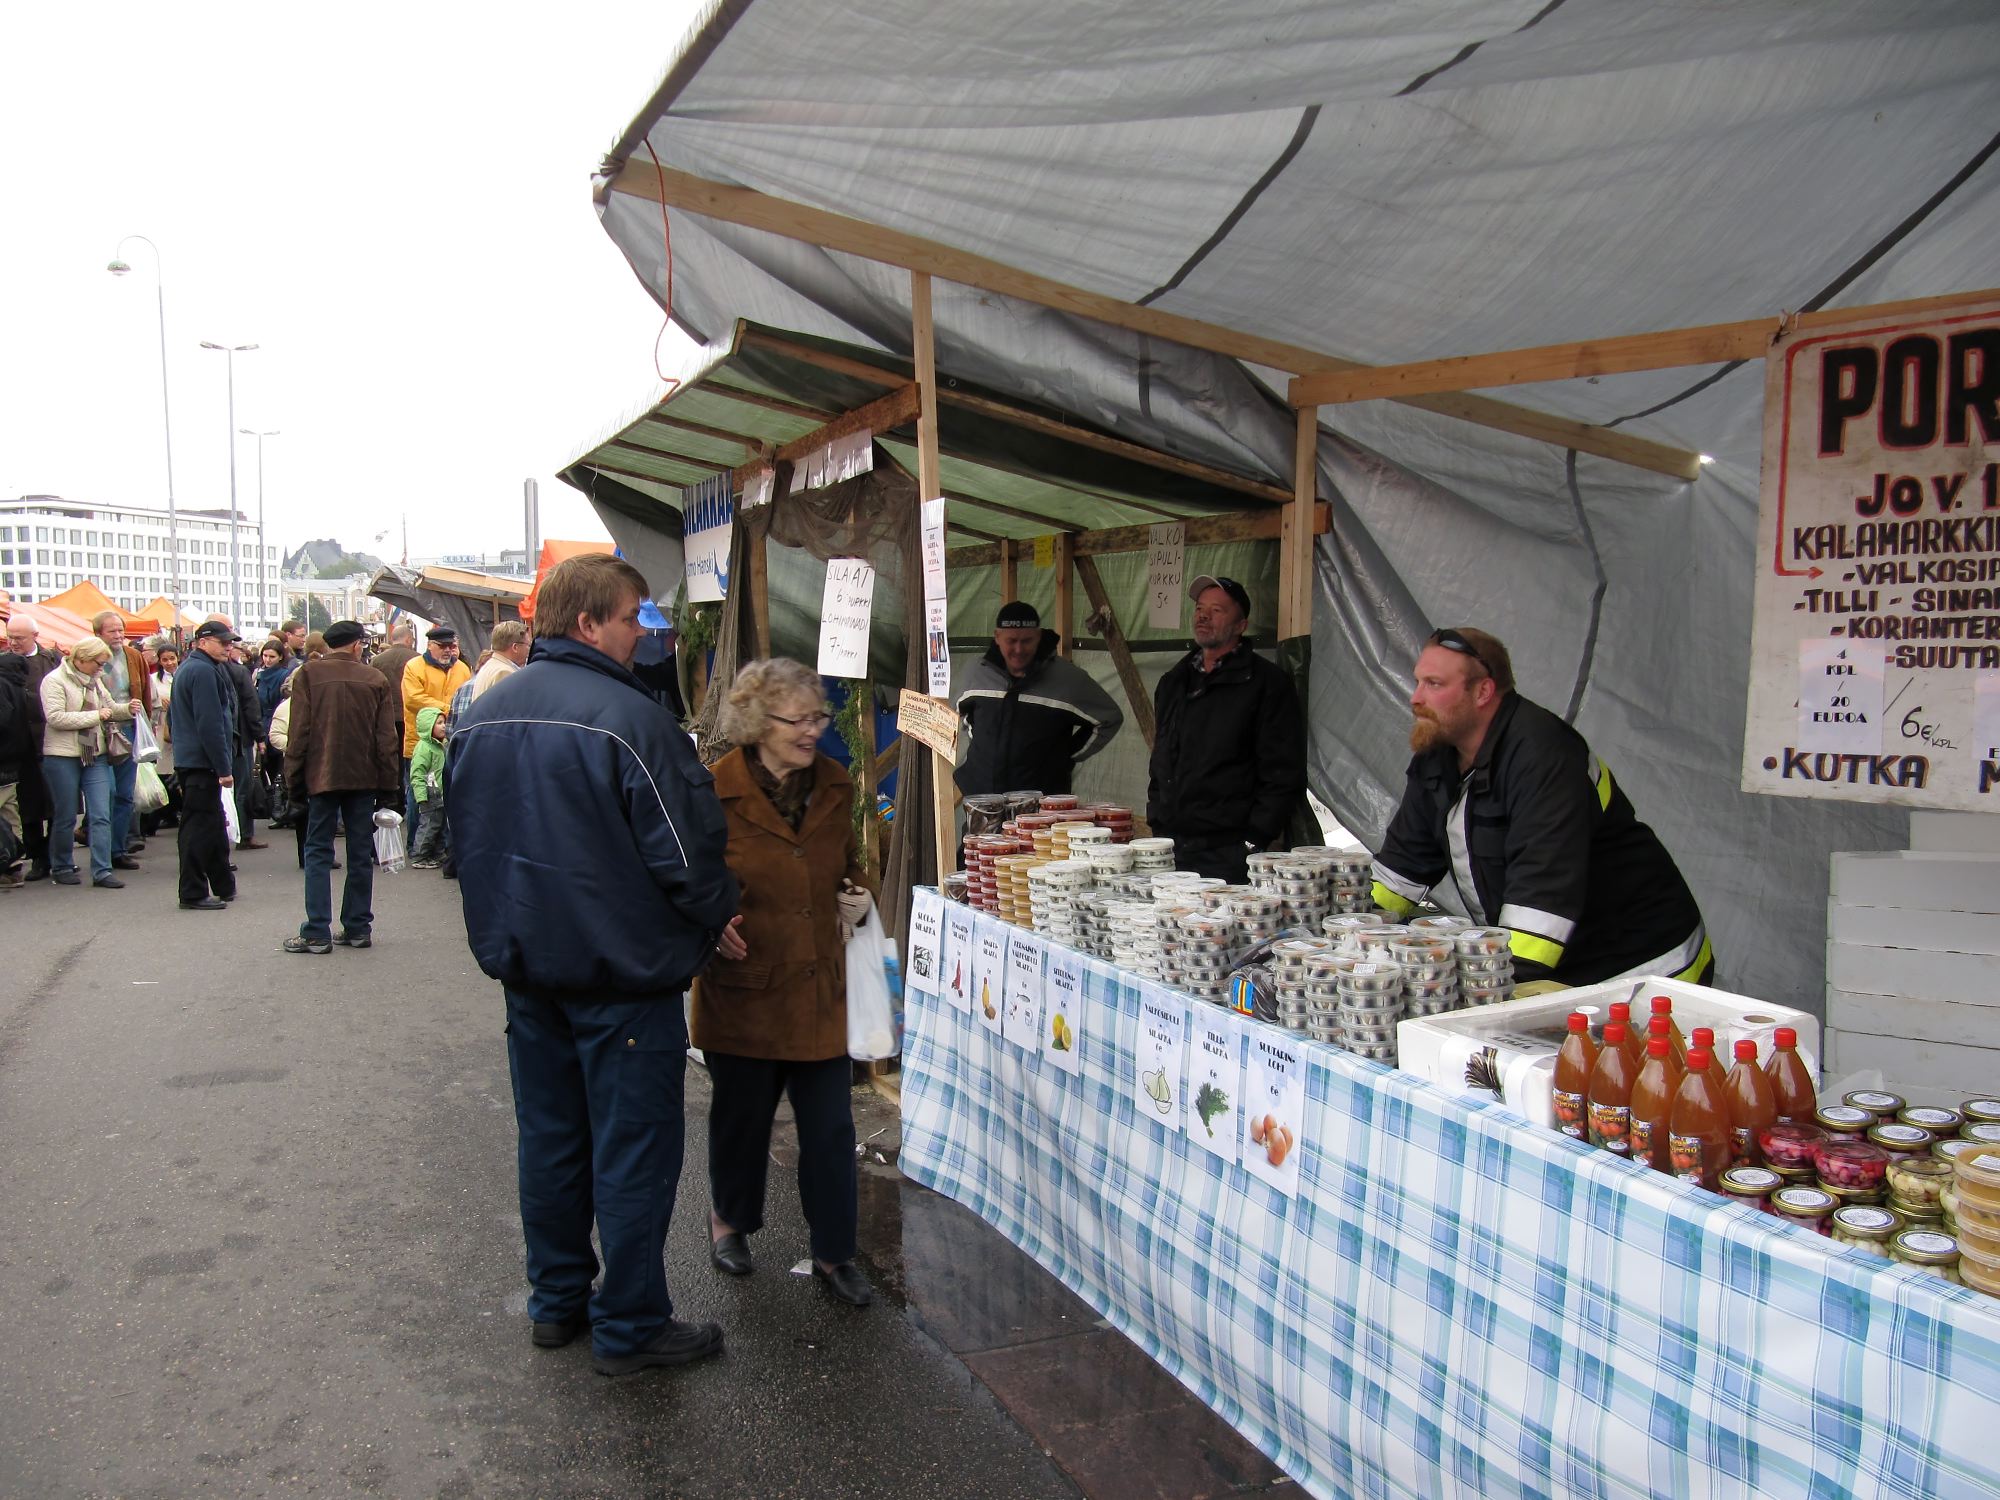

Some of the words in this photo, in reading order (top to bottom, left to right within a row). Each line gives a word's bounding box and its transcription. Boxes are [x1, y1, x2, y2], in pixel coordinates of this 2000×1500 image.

[1836, 648, 1847, 660] 4
[1825, 664, 1857, 676] KPL
[1831, 695, 1851, 708] 20
[1812, 711, 1868, 724] EUROA
[1267, 1057, 1285, 1073] LOHI
